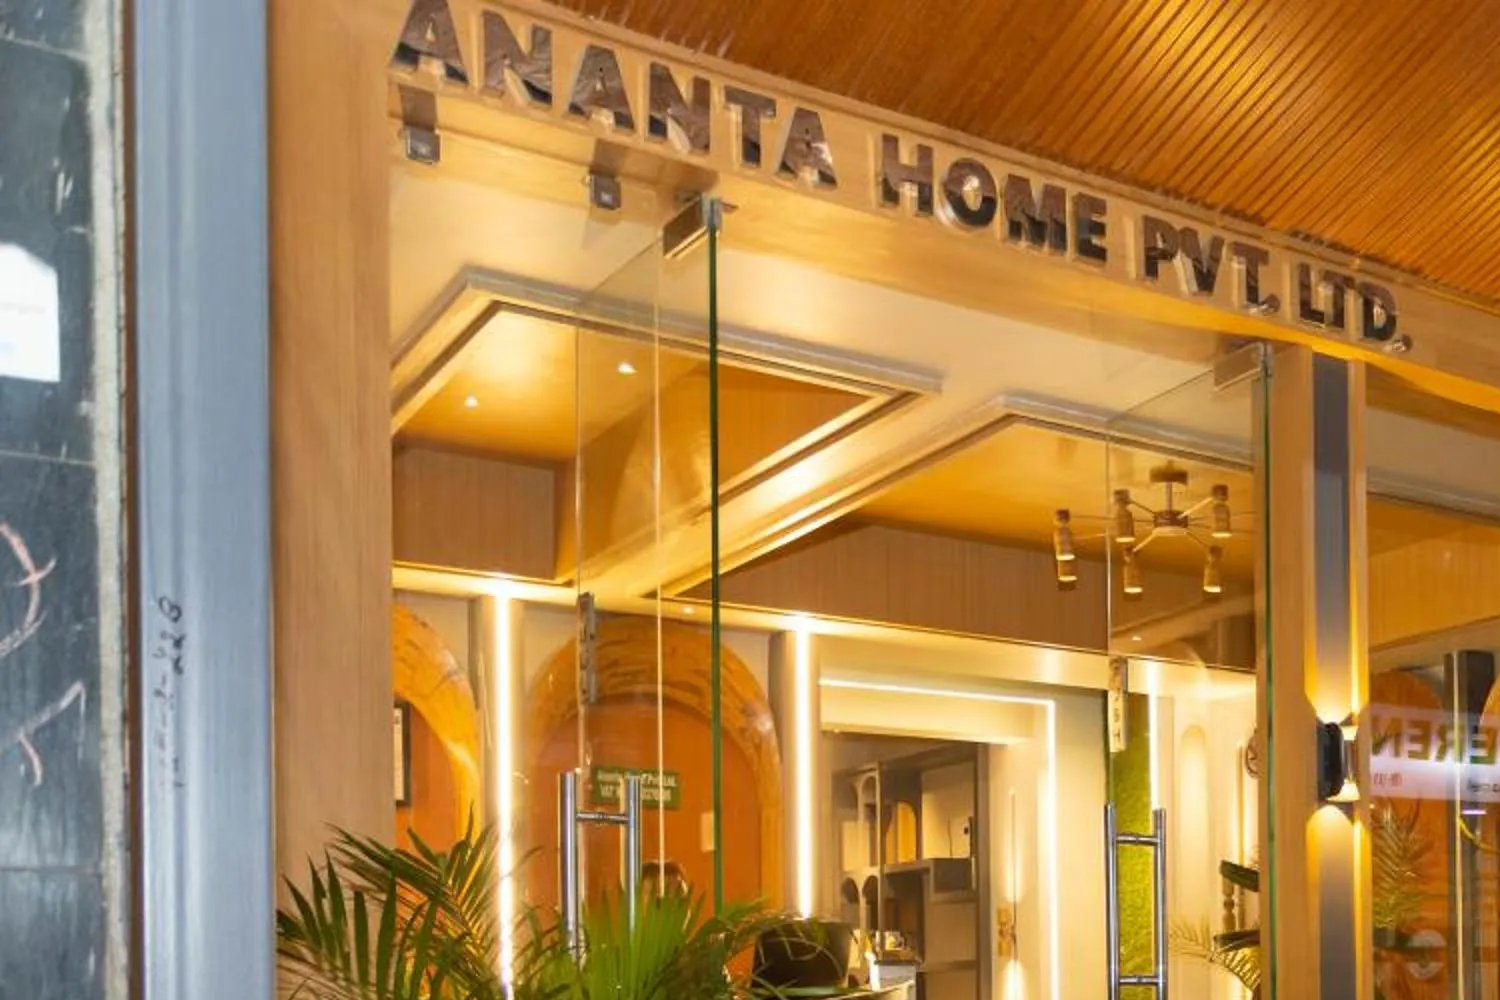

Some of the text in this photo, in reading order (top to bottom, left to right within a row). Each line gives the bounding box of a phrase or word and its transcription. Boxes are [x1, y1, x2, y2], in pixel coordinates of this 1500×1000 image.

[388, 0, 1412, 353] ANANTA HOME PVT. LTD.
